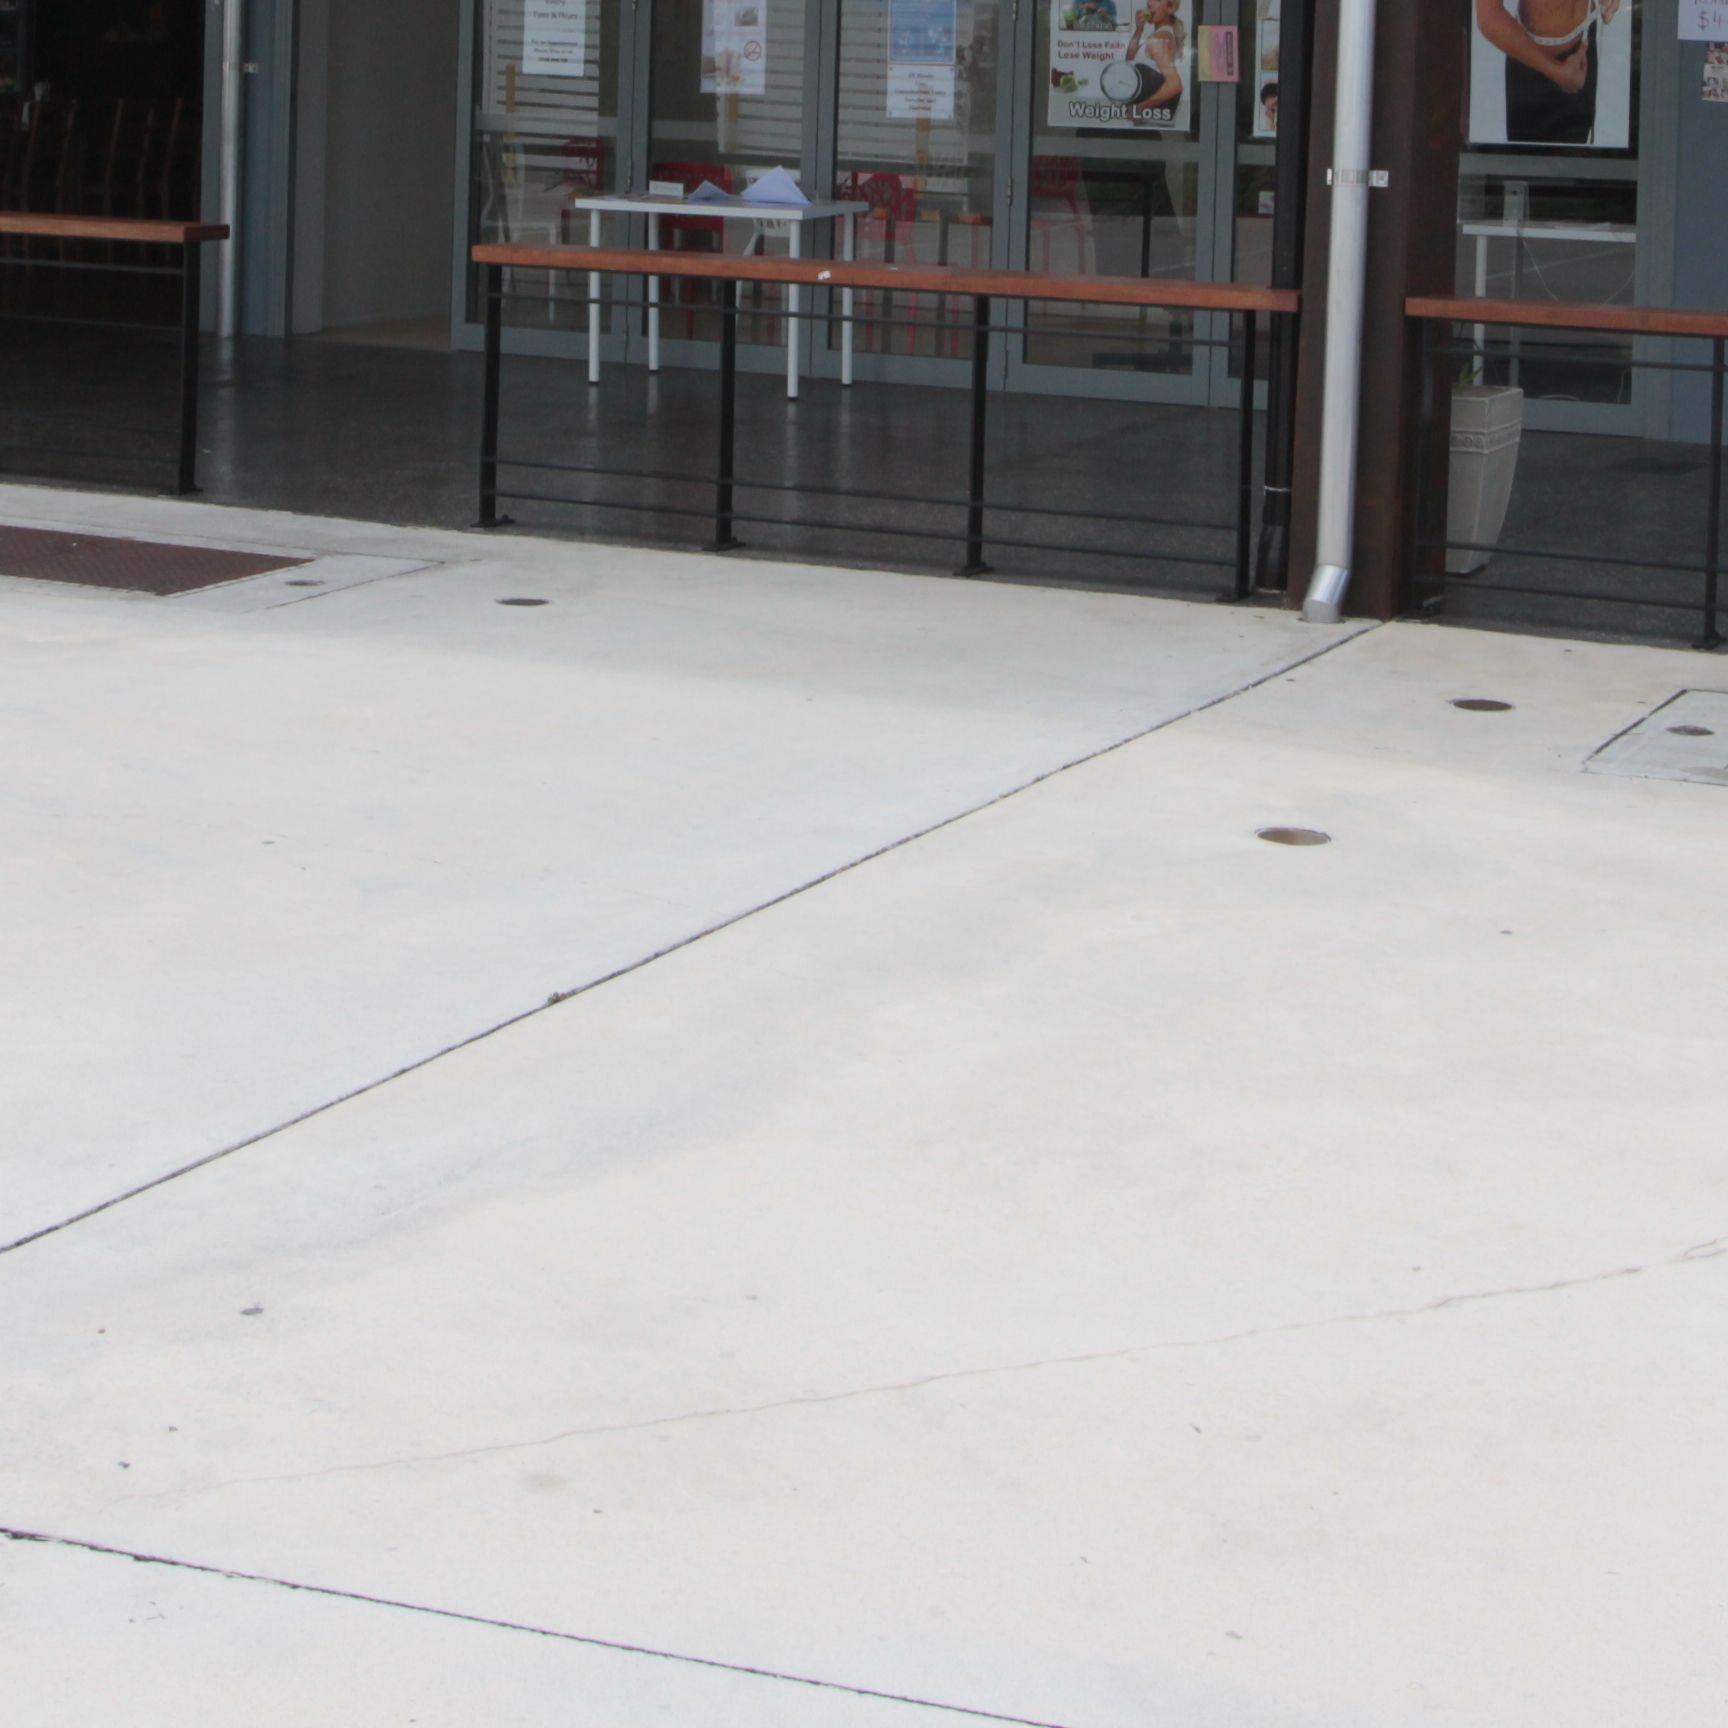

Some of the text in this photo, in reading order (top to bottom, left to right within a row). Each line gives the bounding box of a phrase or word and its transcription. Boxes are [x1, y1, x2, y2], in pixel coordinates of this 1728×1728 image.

[1057, 40, 1080, 48] Don't
[1083, 40, 1102, 49] Lose
[1058, 51, 1115, 61] Lose Weight
[1069, 101, 1171, 122] Weight Loss
